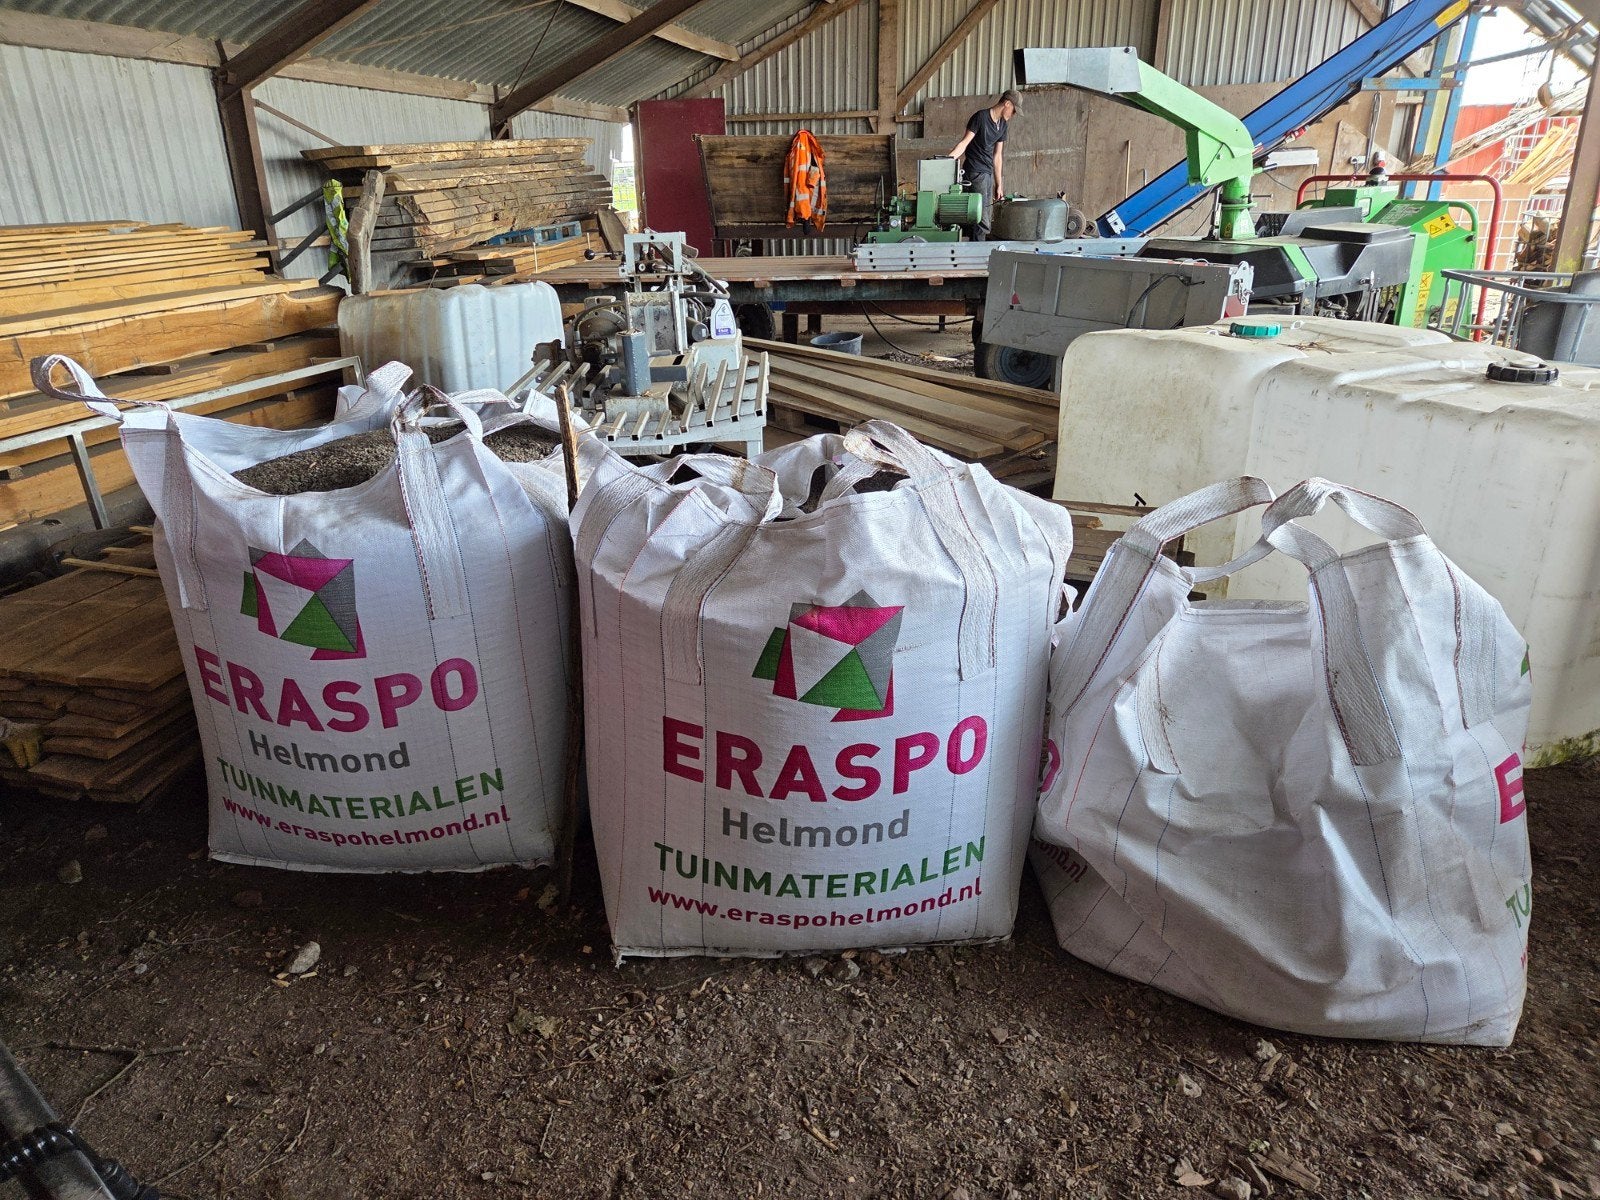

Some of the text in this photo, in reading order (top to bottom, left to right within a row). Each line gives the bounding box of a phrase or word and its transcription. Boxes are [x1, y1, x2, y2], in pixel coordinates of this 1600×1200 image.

[193, 645, 478, 733] ERASPO
[249, 730, 411, 774] Helmond
[662, 714, 988, 803] ERASPO
[217, 756, 505, 820] TUINMATERIALEN
[222, 797, 512, 847] www.eraspohelmond.nl
[722, 807, 910, 848] Helmond
[654, 835, 986, 899] TUINMATERIALEN
[647, 877, 983, 931] www.eraspohelmond.nl
